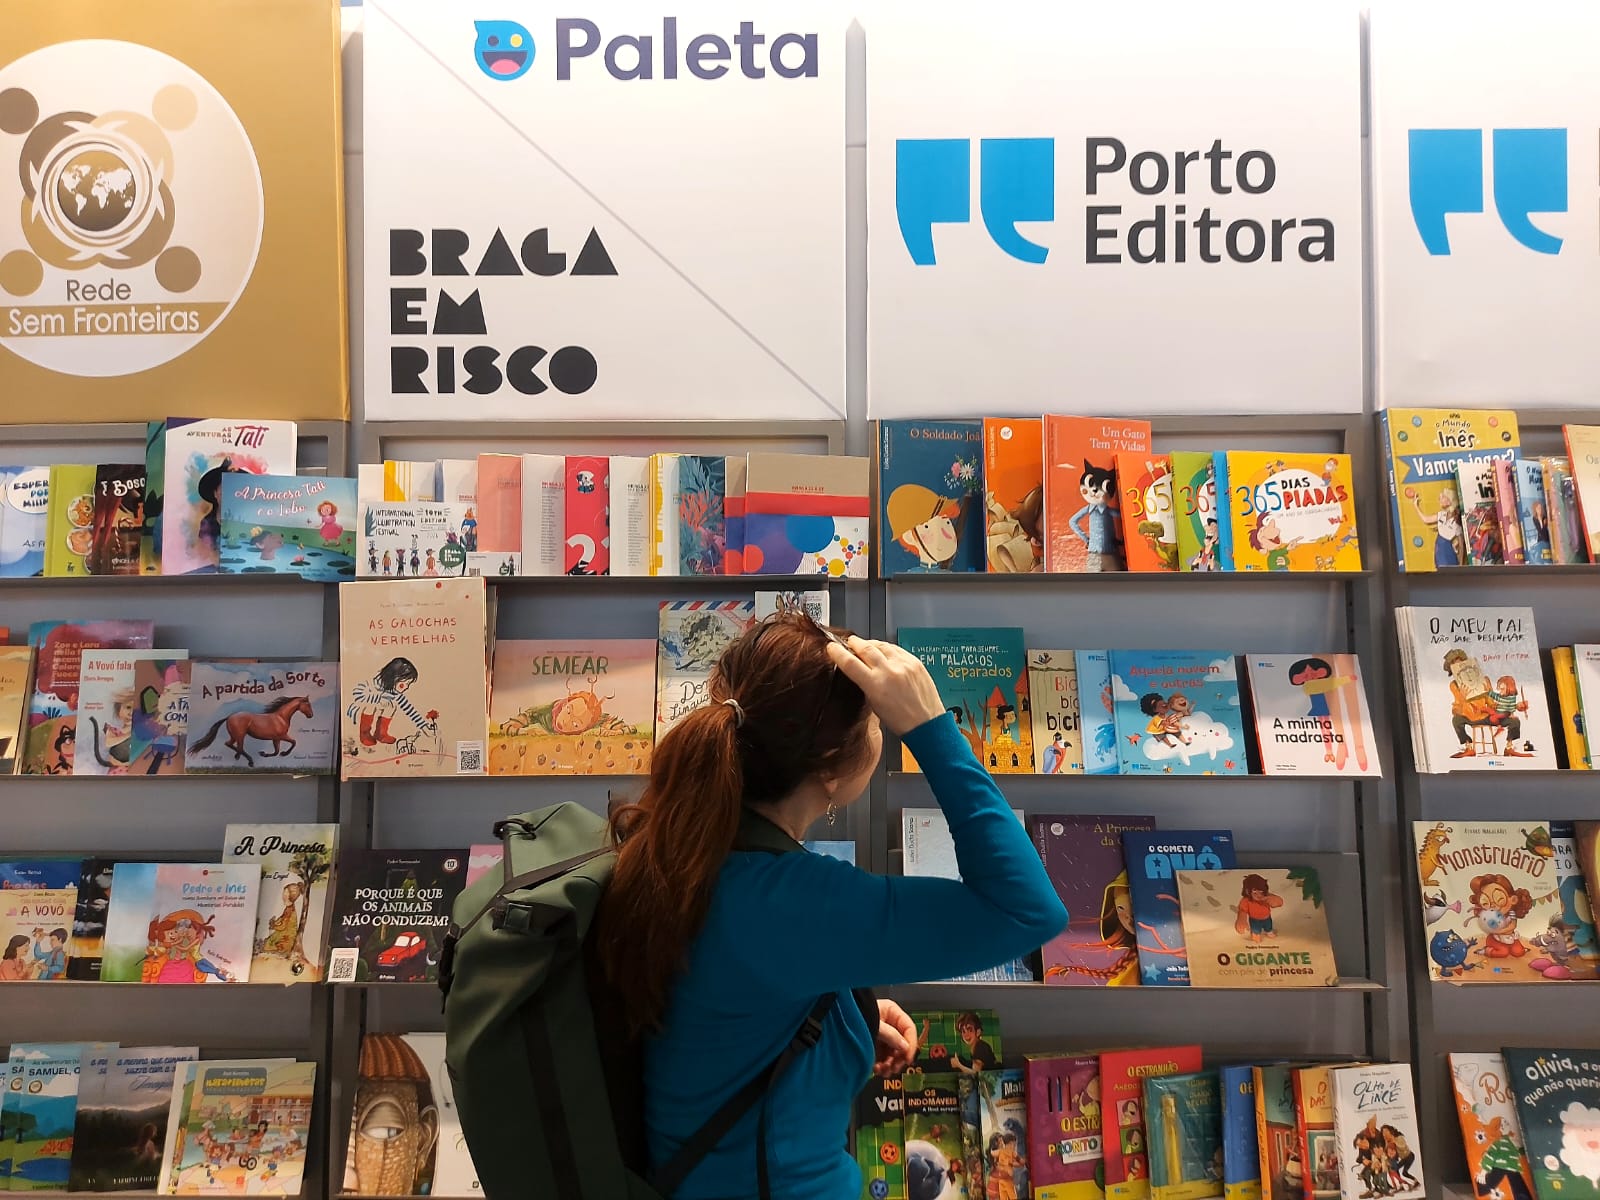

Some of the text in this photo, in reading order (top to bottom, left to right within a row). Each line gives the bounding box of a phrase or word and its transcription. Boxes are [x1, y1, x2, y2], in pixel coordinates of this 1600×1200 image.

[556, 16, 818, 81] Paleta
[1085, 137, 1277, 195] Porto
[1085, 204, 1335, 264] Editora
[390, 226, 619, 276] BRAGA
[66, 278, 132, 301] Rede
[390, 287, 488, 335] EM
[8, 306, 200, 335] Sem Fronteiras
[391, 345, 598, 395] RISCO
[234, 425, 270, 449] Tati
[910, 428, 920, 439] O
[922, 429, 963, 440] Soldado
[1102, 426, 1145, 439] Um Gato
[1438, 430, 1475, 448] Inês
[1090, 438, 1145, 451] Tem 7 Vidas
[252, 485, 302, 500] Princesa
[302, 480, 326, 495] Tati
[1281, 477, 1310, 490] DIAS
[1126, 482, 1171, 518] 365
[1236, 481, 1282, 516] 365
[1283, 485, 1348, 510] PIADAS
[369, 617, 457, 630] AS GALOCHAS
[1430, 617, 1522, 634] O MEU PAI
[371, 634, 456, 645] VERMELHAS
[88, 661, 94, 670] A
[532, 655, 609, 675] SEMEAR
[920, 654, 935, 665] EM
[947, 664, 1012, 681] separados
[202, 671, 326, 700] A partida da Sorte
[165, 711, 188, 723] COM
[1273, 717, 1333, 730] A minha
[1275, 732, 1344, 743] madrasta
[1093, 823, 1151, 833] A Princesa
[234, 836, 327, 856] A Princesa
[1100, 837, 1114, 846] da
[1157, 845, 1194, 853] COMETA
[1436, 843, 1548, 877] Monstruário
[182, 883, 212, 893] Pedro
[354, 886, 443, 900] PORQUE É QUE
[21, 905, 29, 917] A
[362, 902, 432, 912] OS ANIMAIS
[342, 913, 449, 927] NÃO CONDUZEM?
[1217, 952, 1312, 966] O GIGANTE
[1270, 966, 1314, 976] princesa
[29, 1067, 71, 1077] SAMUEL,
[1127, 1061, 1178, 1077] O ESTRANHÃO
[1581, 1062, 1589, 1071] a
[883, 1079, 902, 1090] IND
[1524, 1086, 1544, 1107] que
[1544, 1079, 1563, 1094] não
[908, 1097, 957, 1106] INDOMÁVEIS
[1061, 1117, 1071, 1132] O
[1048, 1140, 1098, 1157] PRONTO
